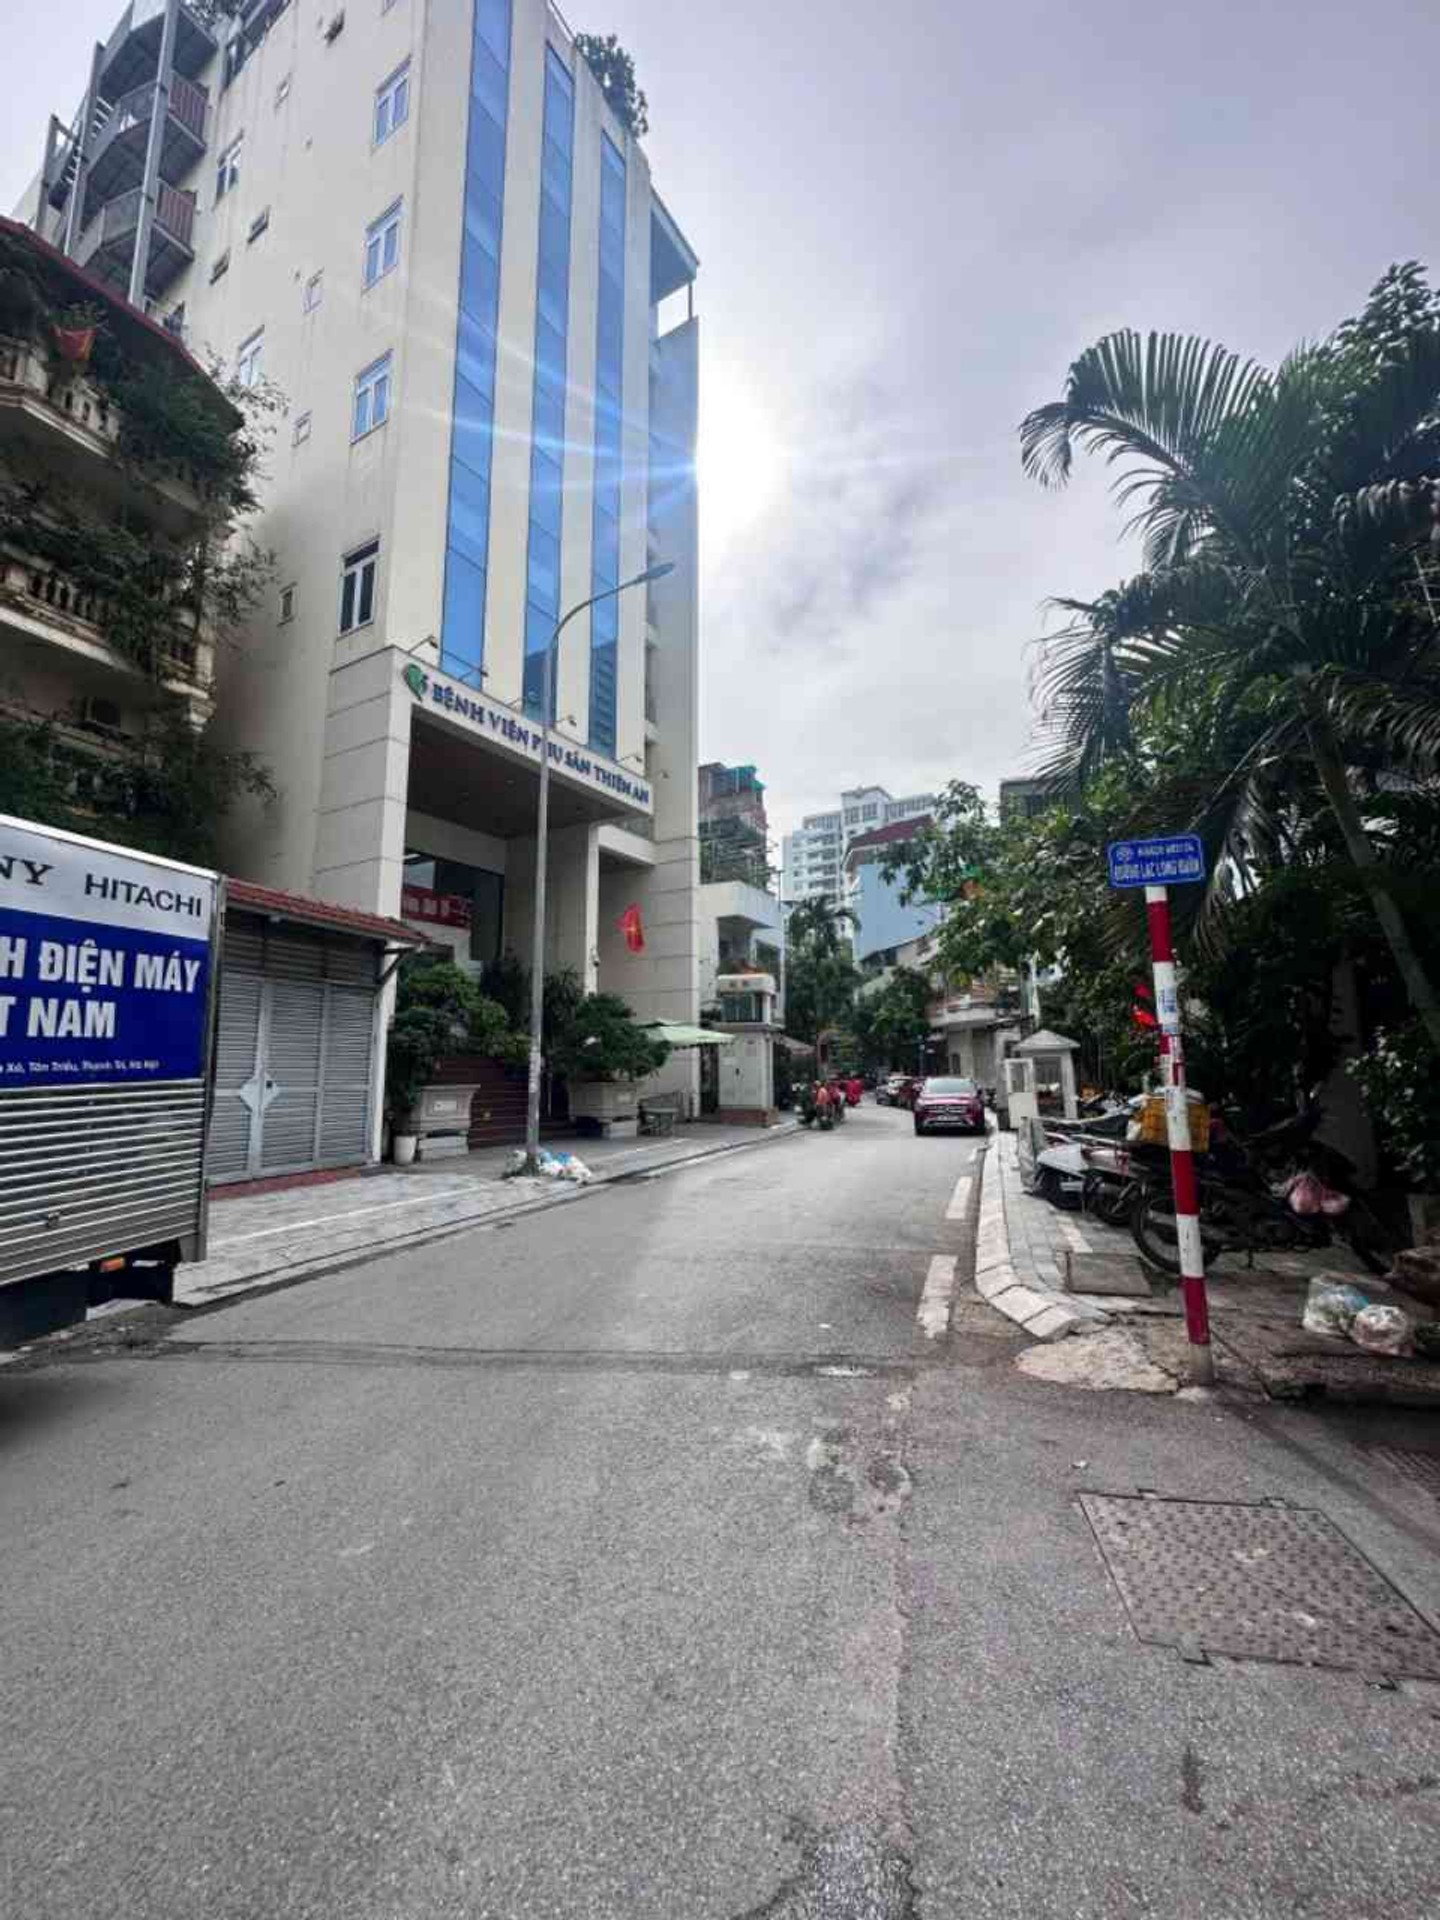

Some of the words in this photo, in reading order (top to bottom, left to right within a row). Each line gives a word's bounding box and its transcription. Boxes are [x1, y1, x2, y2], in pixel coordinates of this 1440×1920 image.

[84, 873, 202, 917] HITACHI
[38, 938, 125, 994] ĐIỆN
[134, 951, 201, 993] MÁY
[26, 997, 116, 1038] NAM
